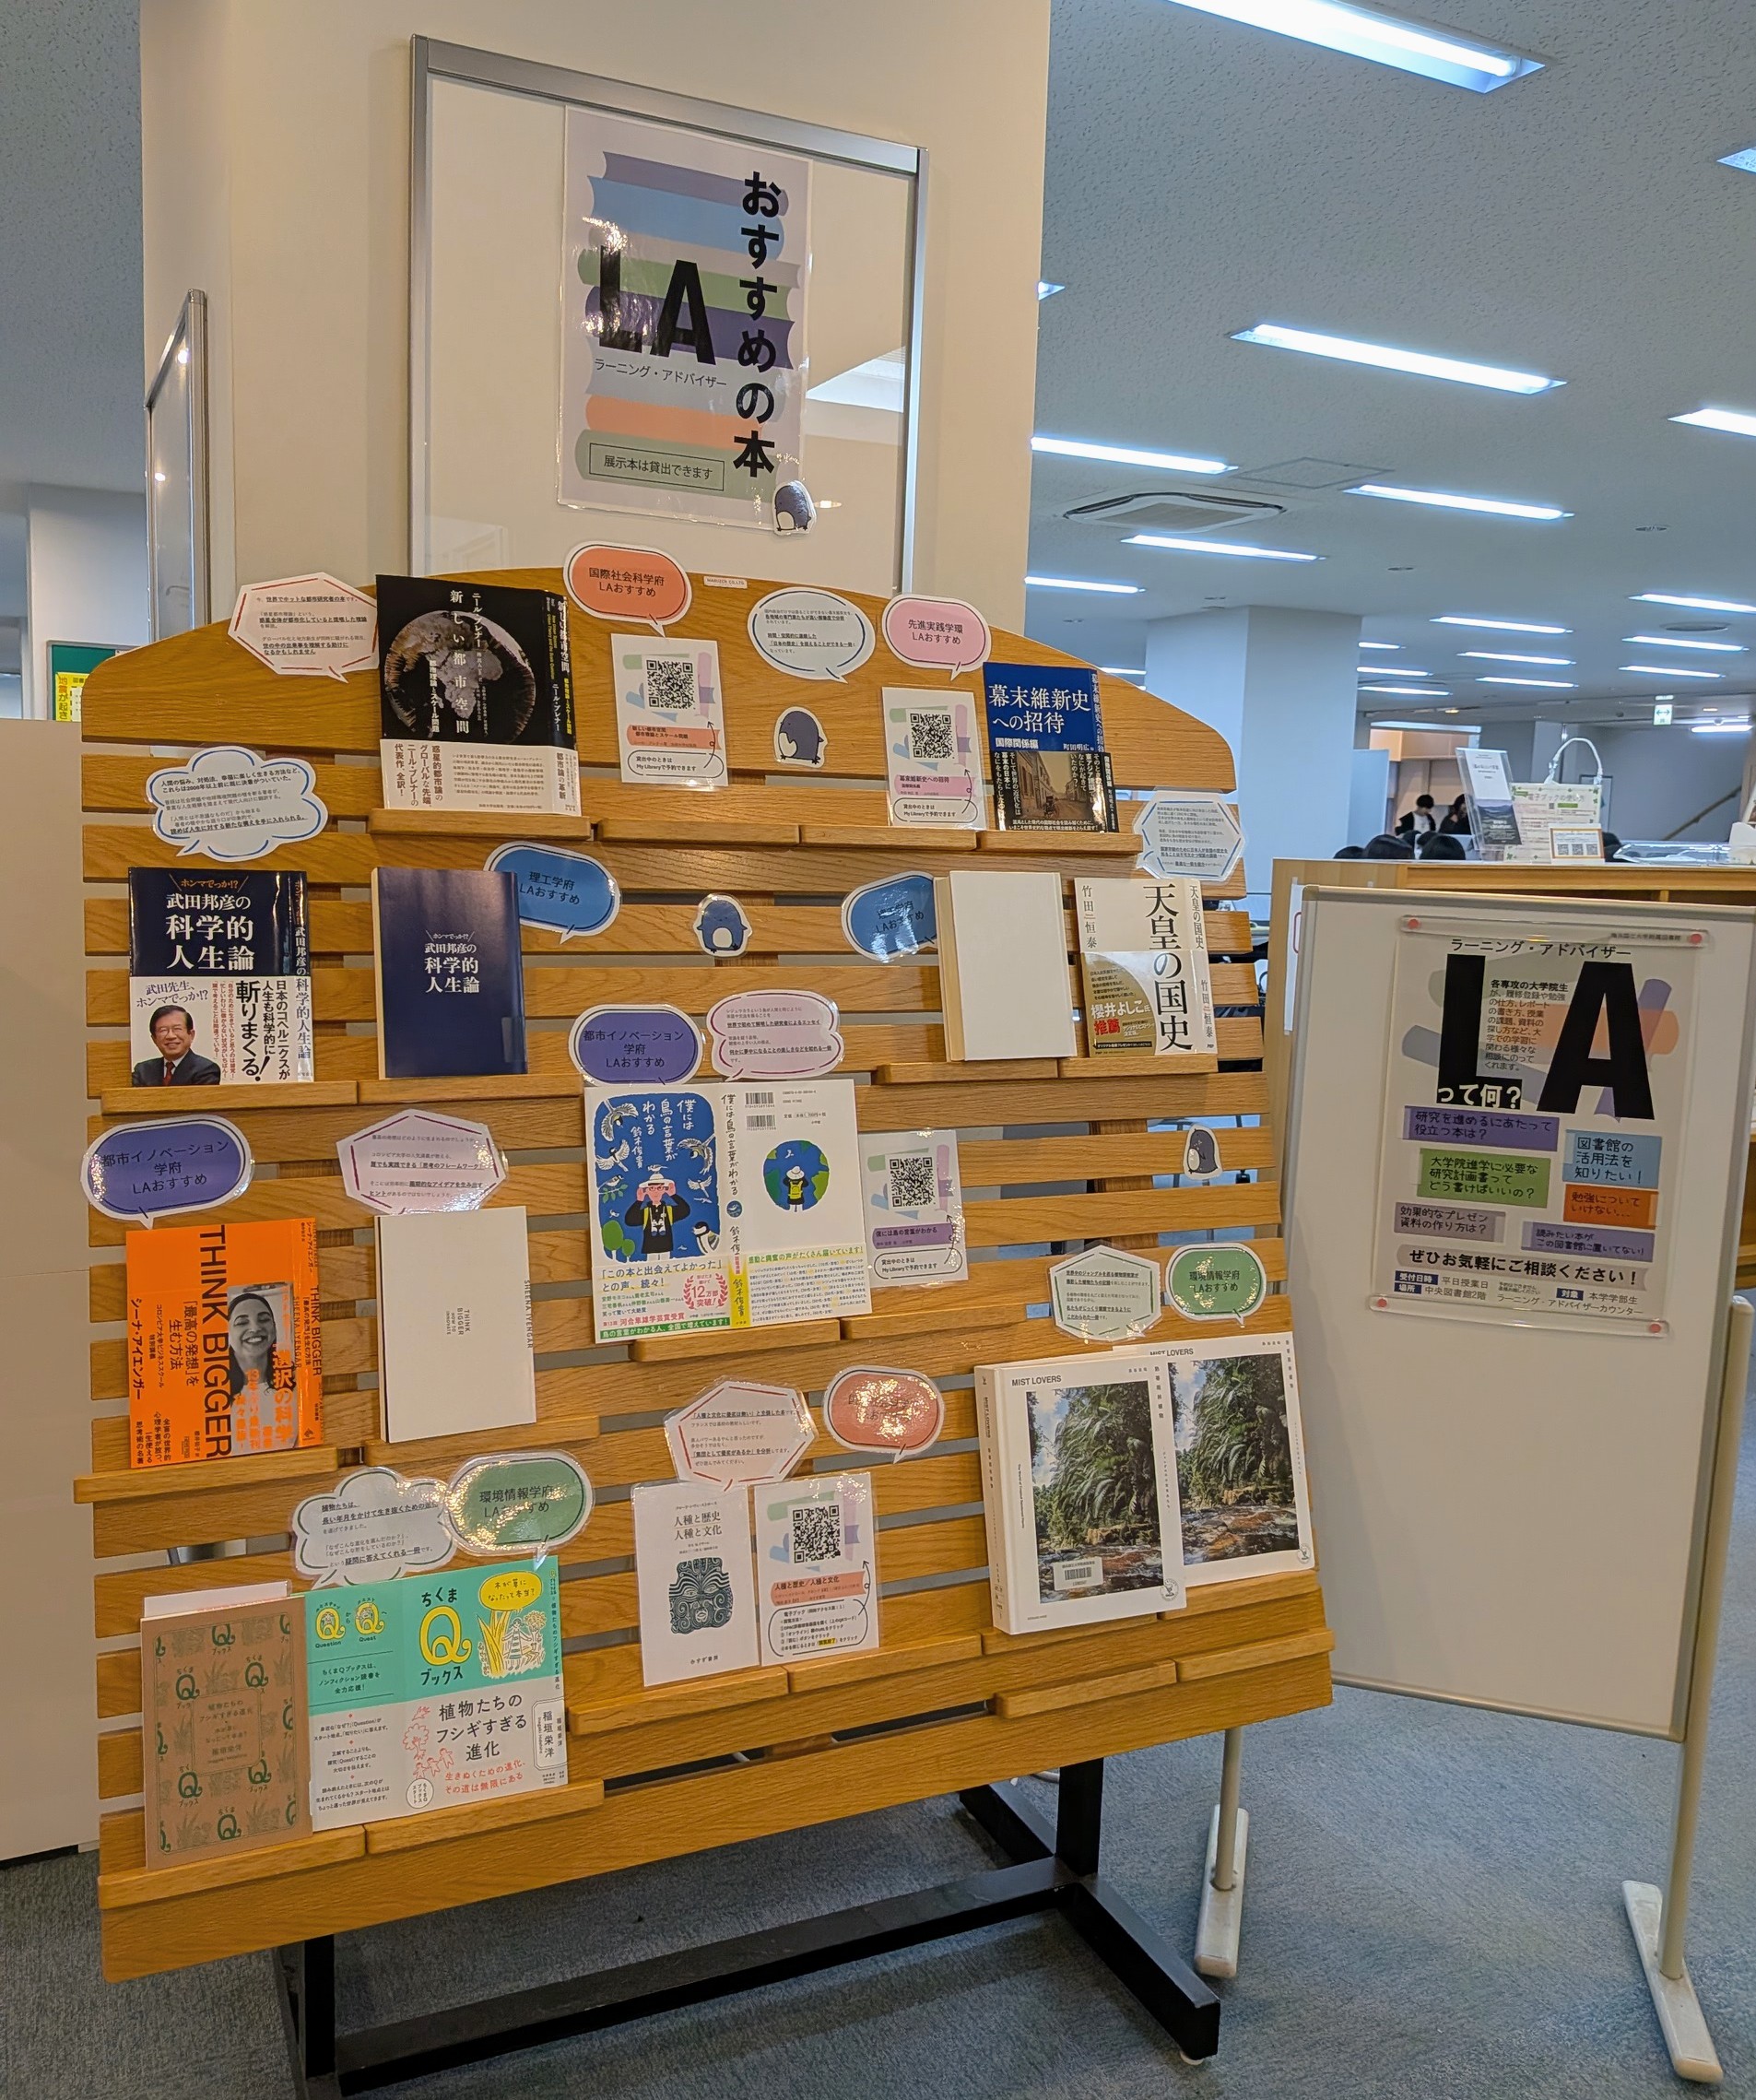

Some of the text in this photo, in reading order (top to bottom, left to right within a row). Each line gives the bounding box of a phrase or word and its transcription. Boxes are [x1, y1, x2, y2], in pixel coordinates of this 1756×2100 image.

[599, 245, 716, 365] LA
[733, 171, 781, 478] おすすめの本
[595, 358, 726, 387] ラーニング・アドバイザー
[604, 454, 713, 480] 展示本は貸出できます
[589, 568, 665, 586] 国際社会科学府
[599, 582, 656, 597] LAおすすめ
[472, 593, 483, 648] ニール・ブレナー
[908, 619, 963, 634] 先進実践学環
[912, 631, 961, 645] LAおすすめ
[450, 589, 470, 735] 新しい都市空間
[988, 684, 1090, 712] 幕末維新史
[992, 711, 1065, 734] への招待
[995, 737, 1039, 749] 国際関係編
[407, 745, 418, 807] ニール・ブレナーの
[431, 746, 443, 801] 惑星的都市論の
[528, 871, 575, 891] 理工学府
[166, 893, 251, 911] 武田邦彦の
[519, 883, 580, 905] LAおすすめ
[1082, 885, 1097, 949] 竹田恒泰
[1189, 885, 1204, 950] 天皇の国史
[166, 914, 254, 941] 科学的
[166, 945, 255, 971] 人生論
[424, 943, 477, 954] 武田邦彦の
[1451, 938, 1632, 959] ラーニング・アドバイザー
[424, 957, 479, 974] 科学的
[1143, 883, 1193, 1051] 天皇の国史
[146, 980, 195, 997] 武田先生、
[425, 977, 480, 994] 人生論
[1489, 989, 1567, 1002] が、履修登録や勉強
[1490, 979, 1569, 993] 各専攻の大学院生
[1091, 999, 1151, 1019] 櫻井よしこ氏
[1201, 980, 1213, 1038] 竹田恒泰
[1489, 997, 1550, 1009] の仕方、レポート
[1489, 1007, 1544, 1019] の書き方、授業
[262, 981, 276, 1056] 人生も科学的に
[1093, 1018, 1121, 1036] 推薦
[1488, 1016, 1544, 1028] の課題、資料の
[236, 980, 270, 1082] 斬りまくる！
[276, 980, 290, 1080] 日本のコペルニクスが
[583, 1030, 684, 1042] 都市イノベーション
[1436, 953, 1655, 1120] LA
[1486, 1033, 1537, 1045] 学での学習に
[1487, 1024, 1541, 1036] 探し方など、大
[624, 1044, 646, 1056] 学府
[1485, 1043, 1536, 1055] 関わる様々な
[1485, 1052, 1535, 1064] 相談にのって
[606, 1056, 665, 1068] LAおすすめ
[1484, 1061, 1521, 1072] くれます。
[643, 1101, 656, 1135] わかる
[677, 1100, 696, 1130] 僕には
[1415, 1111, 1551, 1132] 研究を進めるにあたって
[660, 1099, 678, 1162] 鳥の言葉が
[101, 1140, 229, 1167] 都市イノベーション
[631, 1127, 644, 1169] 鈴木俊貴
[721, 1094, 738, 1196] 僕には鳥の言葉がわかる
[1577, 1137, 1634, 1152] 図書館の
[154, 1161, 183, 1175] 学府
[1431, 1157, 1538, 1175] 大学院進学に必要な
[1575, 1150, 1632, 1168] 活用法を
[133, 1174, 207, 1194] LAおすすめ
[1430, 1168, 1512, 1185] 研究計画書って
[1572, 1191, 1640, 1207] 勉強について
[1400, 1205, 1488, 1223] 効果的なプレゼン
[876, 1227, 937, 1237] 僕には鳥の言葉がわかる
[1536, 1229, 1595, 1241] 読みたい本が
[602, 1259, 722, 1280] 「この本と出会えてよかった」
[1189, 1270, 1240, 1281] 環境情報学府
[1398, 1272, 1433, 1284] 受付日時
[1442, 1276, 1490, 1289] 平日授業日
[691, 1285, 718, 1298] 12万部
[1398, 1283, 1416, 1294] 場所
[1424, 1286, 1487, 1300] 中央図書館2階
[1589, 1292, 1638, 1305] 本学学部生
[1497, 1292, 1644, 1315] ラーニング・アドバイザーカウンター
[523, 1280, 534, 1350] SHEENA IYENGAR
[311, 1286, 322, 1375] THINK BIGGER
[130, 1298, 145, 1400] シーナ・アイエンガー
[169, 1319, 183, 1370] 生む方法
[183, 1301, 200, 1387] 「最高の発想」を
[199, 1224, 231, 1458] THINK BIGGER
[1167, 1348, 1194, 1357] LOVERS
[1011, 1374, 1062, 1386] MIST LOVERS
[478, 1484, 555, 1504] 環境情報学府
[322, 1502, 359, 1512] 植物たちは、
[674, 1511, 721, 1527] 人種と歴史
[674, 1525, 722, 1540] 人種と文化
[495, 1577, 527, 1589] 木が草に
[421, 1587, 458, 1608] ちくま
[315, 1640, 341, 1648] Question
[419, 1606, 472, 1666] Q
[690, 1655, 718, 1665] みすず書房
[420, 1666, 464, 1686] ブックス
[439, 1693, 523, 1723] 植物たちの
[436, 1713, 527, 1743] フシギすぎる
[543, 1712, 555, 1759] 稲垣栄洋
[466, 1740, 500, 1762] 進化
[444, 1760, 526, 1782] 生きぬくための進化、
[444, 1772, 524, 1795] その道は無限にある
